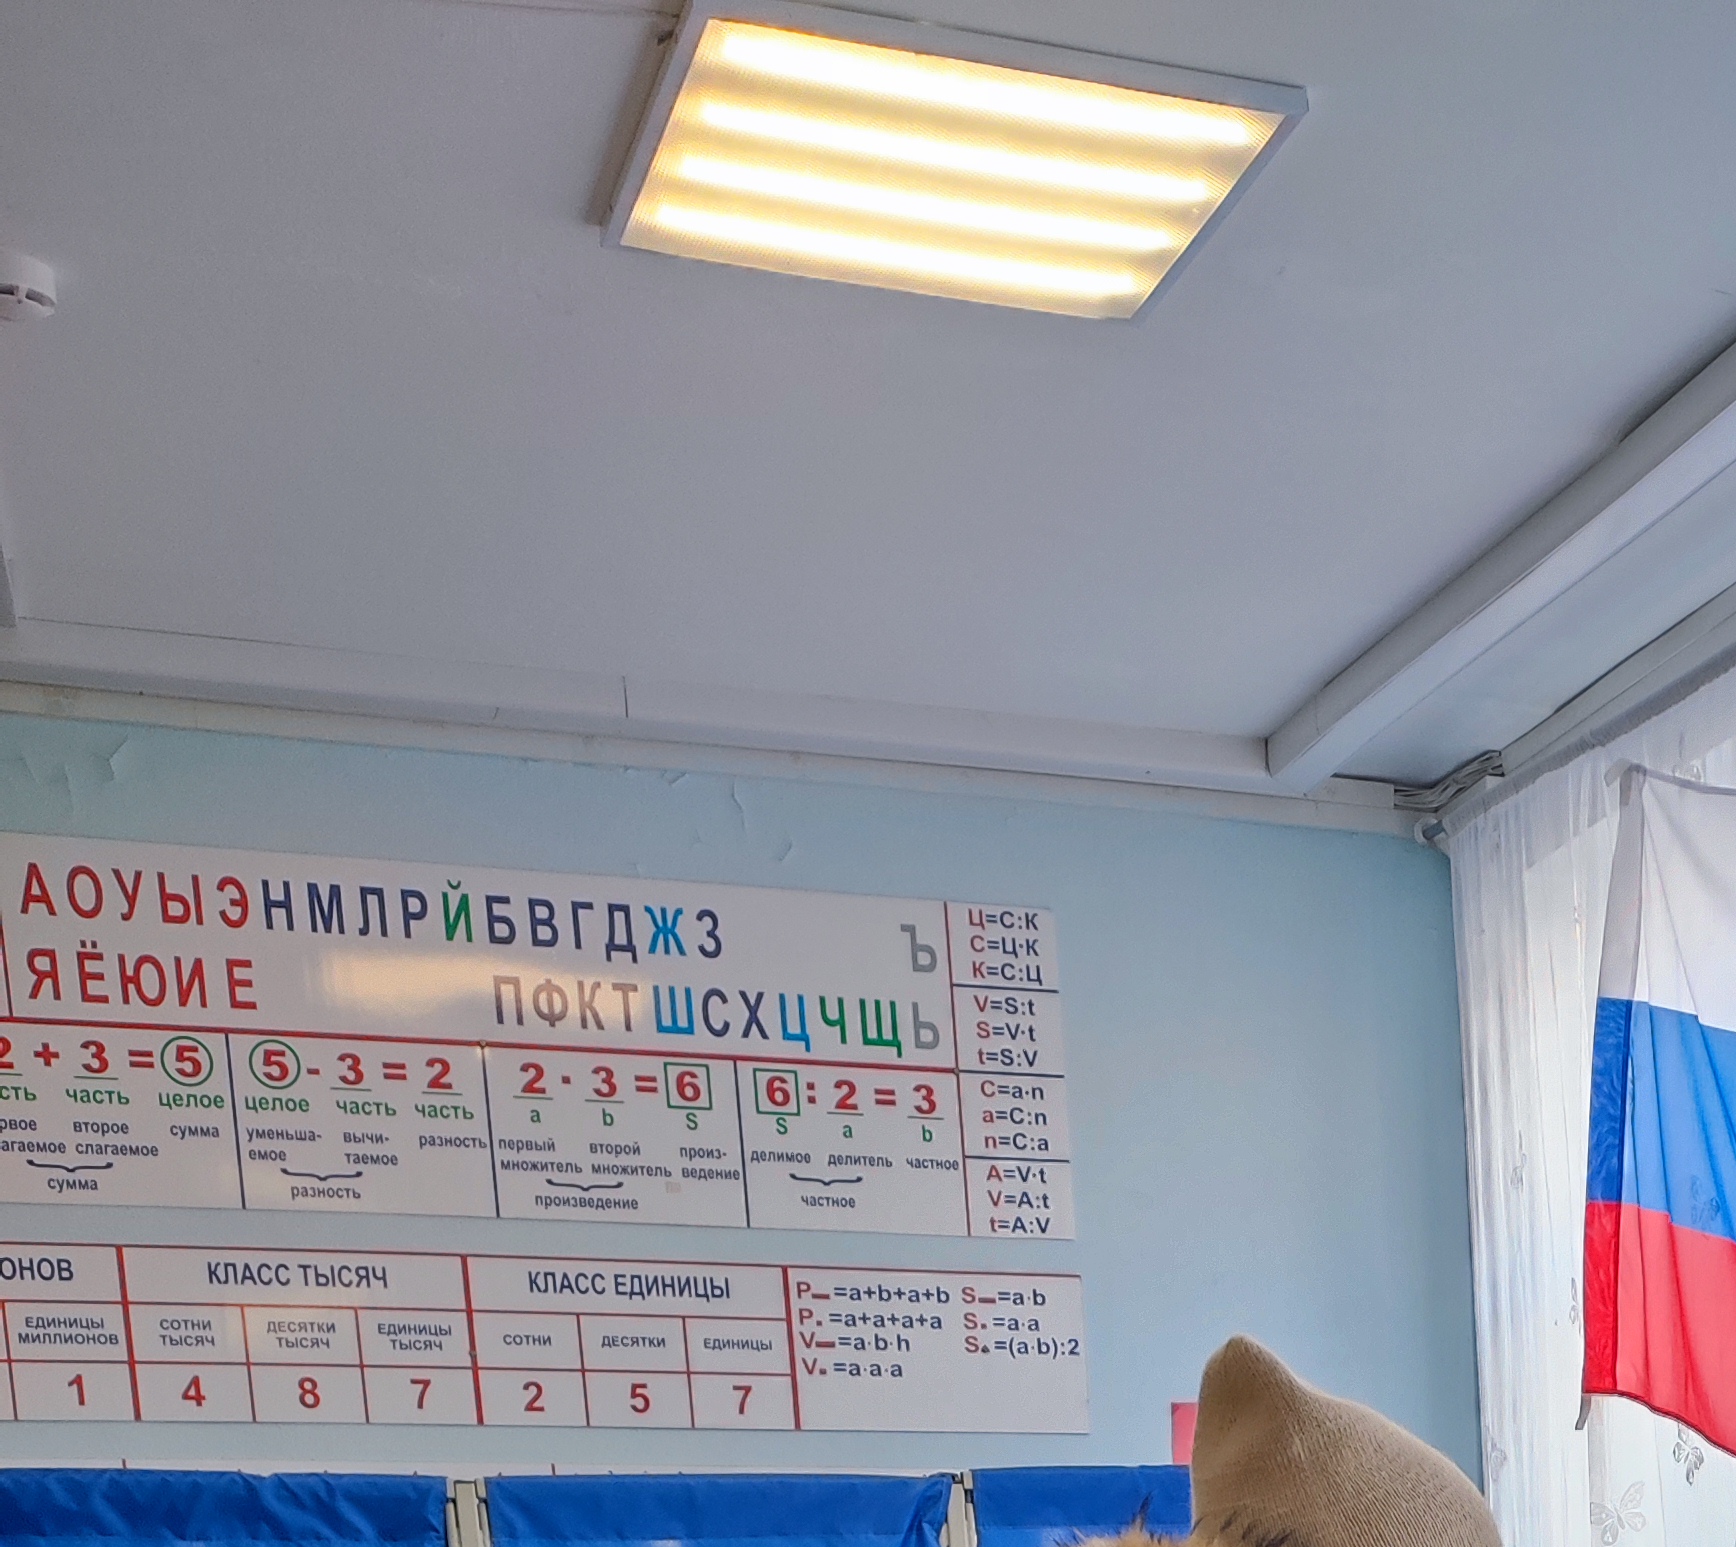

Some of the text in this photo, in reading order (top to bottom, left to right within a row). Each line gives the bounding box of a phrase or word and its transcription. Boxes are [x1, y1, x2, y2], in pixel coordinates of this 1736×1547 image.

[80, 1040, 109, 1074] 3
[174, 1044, 202, 1078] 5
[262, 1049, 289, 1081] 5
[336, 1053, 364, 1085] 3
[425, 1057, 453, 1089] 2
[519, 1062, 546, 1094] 2
[591, 1066, 617, 1097] 3
[676, 1071, 701, 1102] 6
[66, 1088, 130, 1105] часть
[159, 1092, 224, 1110] целое
[766, 1076, 790, 1107] 6
[834, 1080, 858, 1110] 2
[912, 1084, 937, 1115] 3
[245, 1096, 474, 1120] целое часть часть
[73, 1121, 129, 1137] второе
[170, 1124, 219, 1140] сумма
[246, 1127, 322, 1143] уменьша-
[343, 1132, 389, 1144] вычи-
[419, 1134, 487, 1151] разность
[499, 1138, 555, 1153] первый
[75, 1143, 159, 1156] слагаемое
[249, 1149, 286, 1161] емое
[589, 1141, 641, 1158] второй
[680, 1147, 727, 1162] произ-
[344, 1152, 398, 1165] таемое
[751, 1151, 811, 1164] делимое
[828, 1154, 893, 1168] делитель
[907, 1157, 959, 1170] частное
[501, 1159, 582, 1174] множитель
[591, 1163, 672, 1177] множитель
[682, 1167, 740, 1181] ведение
[47, 1178, 98, 1193] сумма
[291, 1186, 361, 1201] разность
[535, 1194, 638, 1210] произведение
[801, 1195, 855, 1208] частное
[208, 1262, 388, 1288] КЛАСС ТЫСЯЧ
[528, 1271, 731, 1302] КЛАСС ЕДИНИЦЫ
[25, 1317, 104, 1331] ЕДИНИЦЫ
[159, 1318, 212, 1332] СОТНИ
[267, 1320, 336, 1334] ДЕСЯТКИ
[377, 1323, 452, 1337] ЕДИНИЦЫ
[18, 1332, 119, 1346] МИЛЛИОНОВ
[159, 1334, 215, 1347] ТЫСЯЧ
[276, 1336, 330, 1349] ТЫСЯЧ
[390, 1338, 443, 1352] ТЫСЯЧ
[503, 1334, 552, 1347] СОТНИ
[601, 1335, 666, 1349] ДЕСЯТКИ
[704, 1337, 772, 1352] ЕДИНИЦЫ
[68, 1374, 85, 1406] 1
[182, 1375, 206, 1407] 4
[298, 1376, 321, 1409] 8
[410, 1378, 431, 1410] 7
[523, 1381, 545, 1412] 2
[630, 1382, 651, 1413] 5
[732, 1385, 753, 1415] 7
